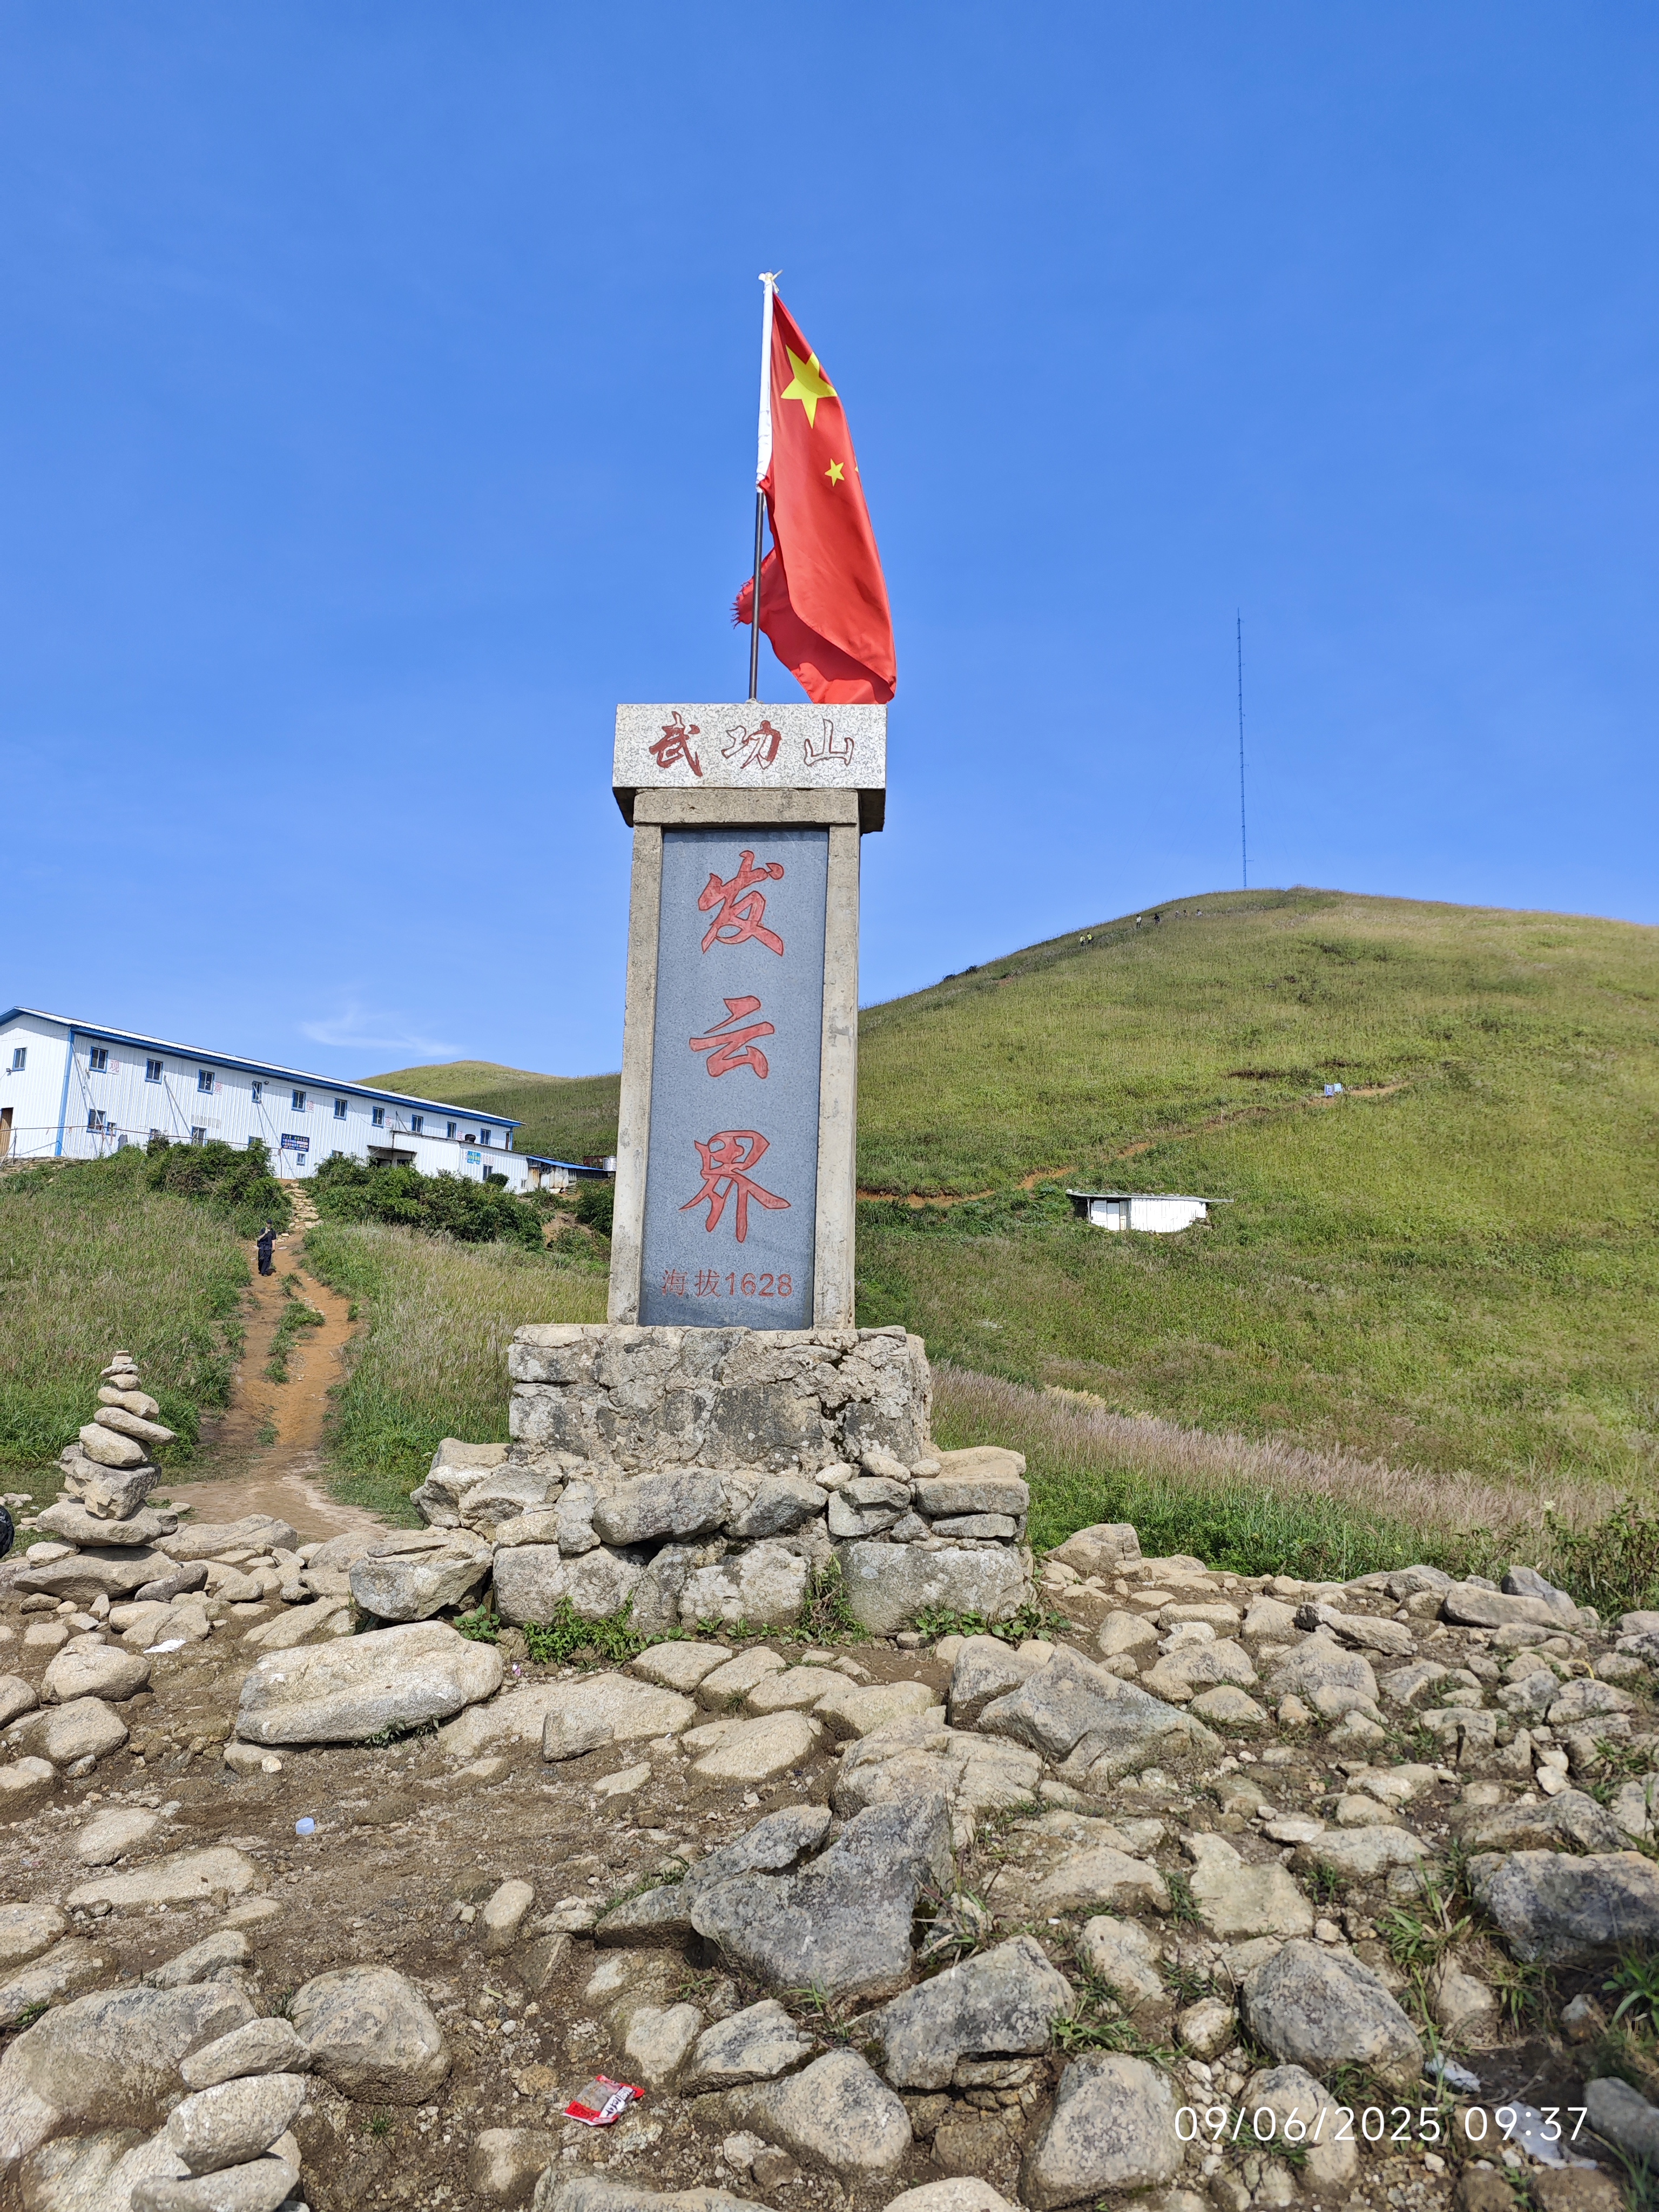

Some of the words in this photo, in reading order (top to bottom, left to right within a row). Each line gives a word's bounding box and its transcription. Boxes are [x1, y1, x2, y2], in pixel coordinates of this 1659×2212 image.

[649, 711, 854, 777] 武功山
[678, 849, 791, 1243] 发云界
[661, 1269, 793, 1298] 海拔1628
